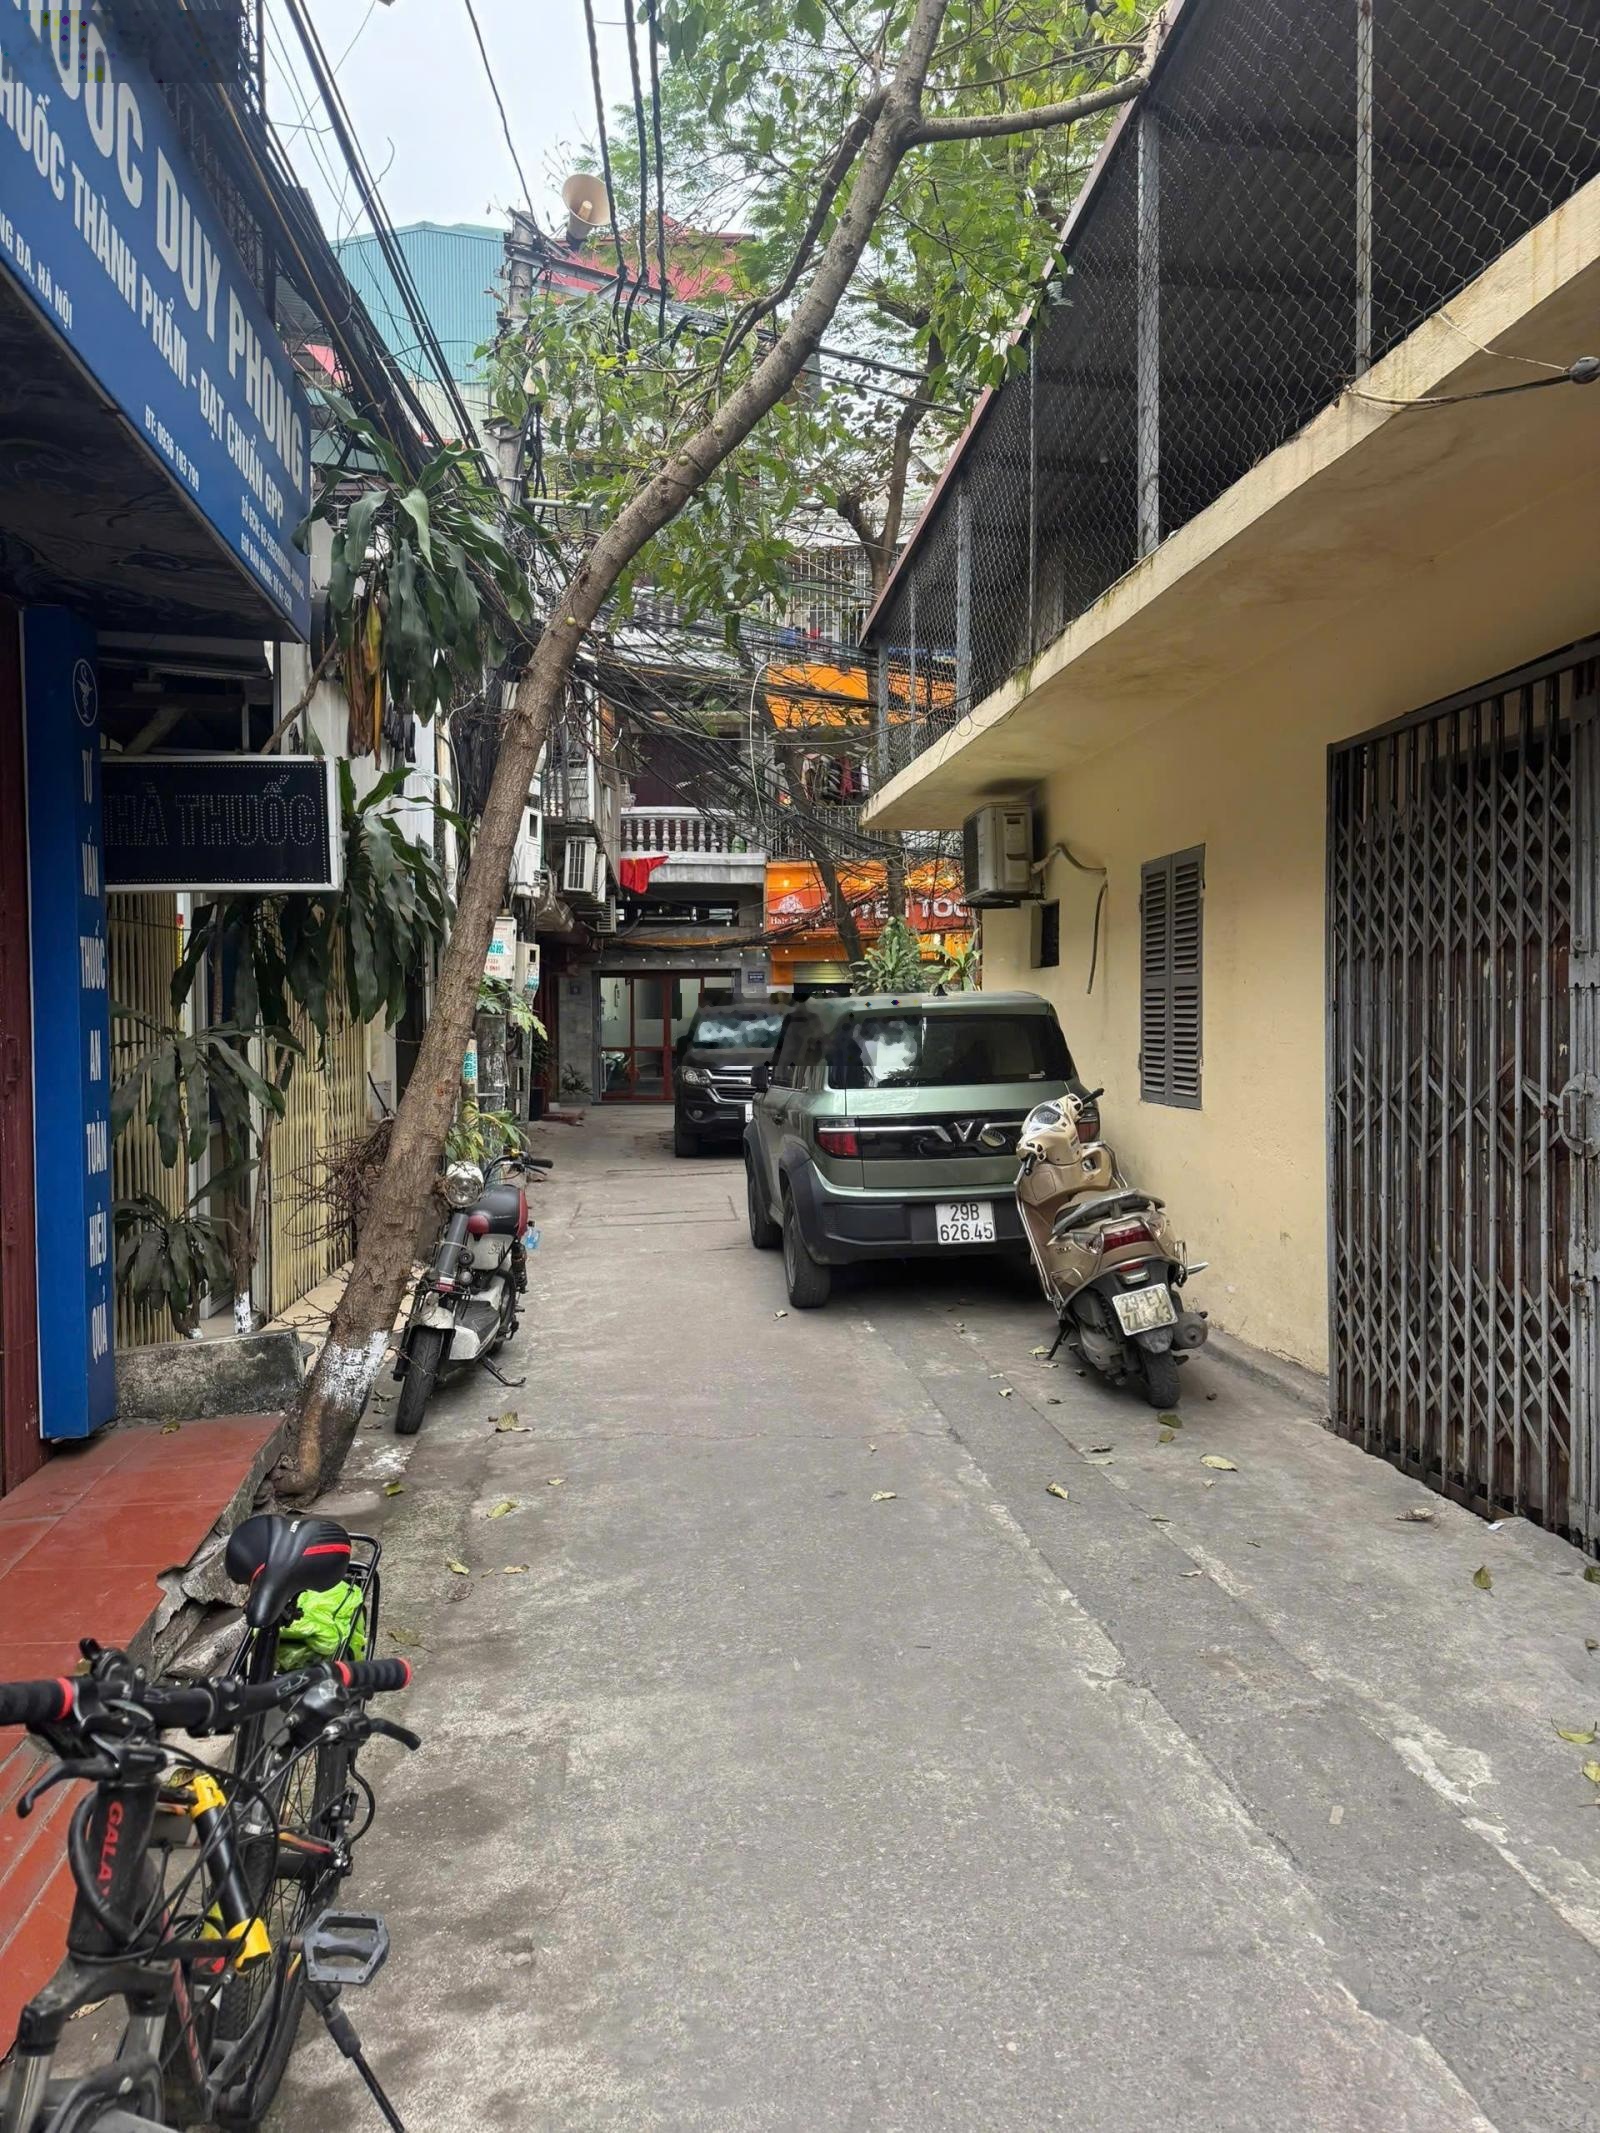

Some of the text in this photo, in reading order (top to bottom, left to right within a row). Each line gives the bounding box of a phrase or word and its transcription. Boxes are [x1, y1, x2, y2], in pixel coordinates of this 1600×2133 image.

[38, 260, 52, 304] HÀ
[55, 283, 73, 329] NỘI
[157, 146, 221, 343] DUY
[229, 285, 304, 495] PHONG
[71, 160, 137, 313] THÀNH
[142, 272, 187, 388] PHẨM
[200, 368, 224, 441] ĐẠT
[226, 412, 263, 502] CHUẨN
[265, 472, 284, 529] GPP
[104, 774, 317, 847] HÀ THUỐC
[80, 919, 106, 990] THUỐC
[90, 1029, 102, 1081] AN
[86, 1110, 107, 1175] TOÀN
[89, 1202, 107, 1276] HIỆU
[940, 1222, 993, 1242] 626.45
[950, 1203, 980, 1222] 29B
[92, 1285, 108, 1365] QUẢ
